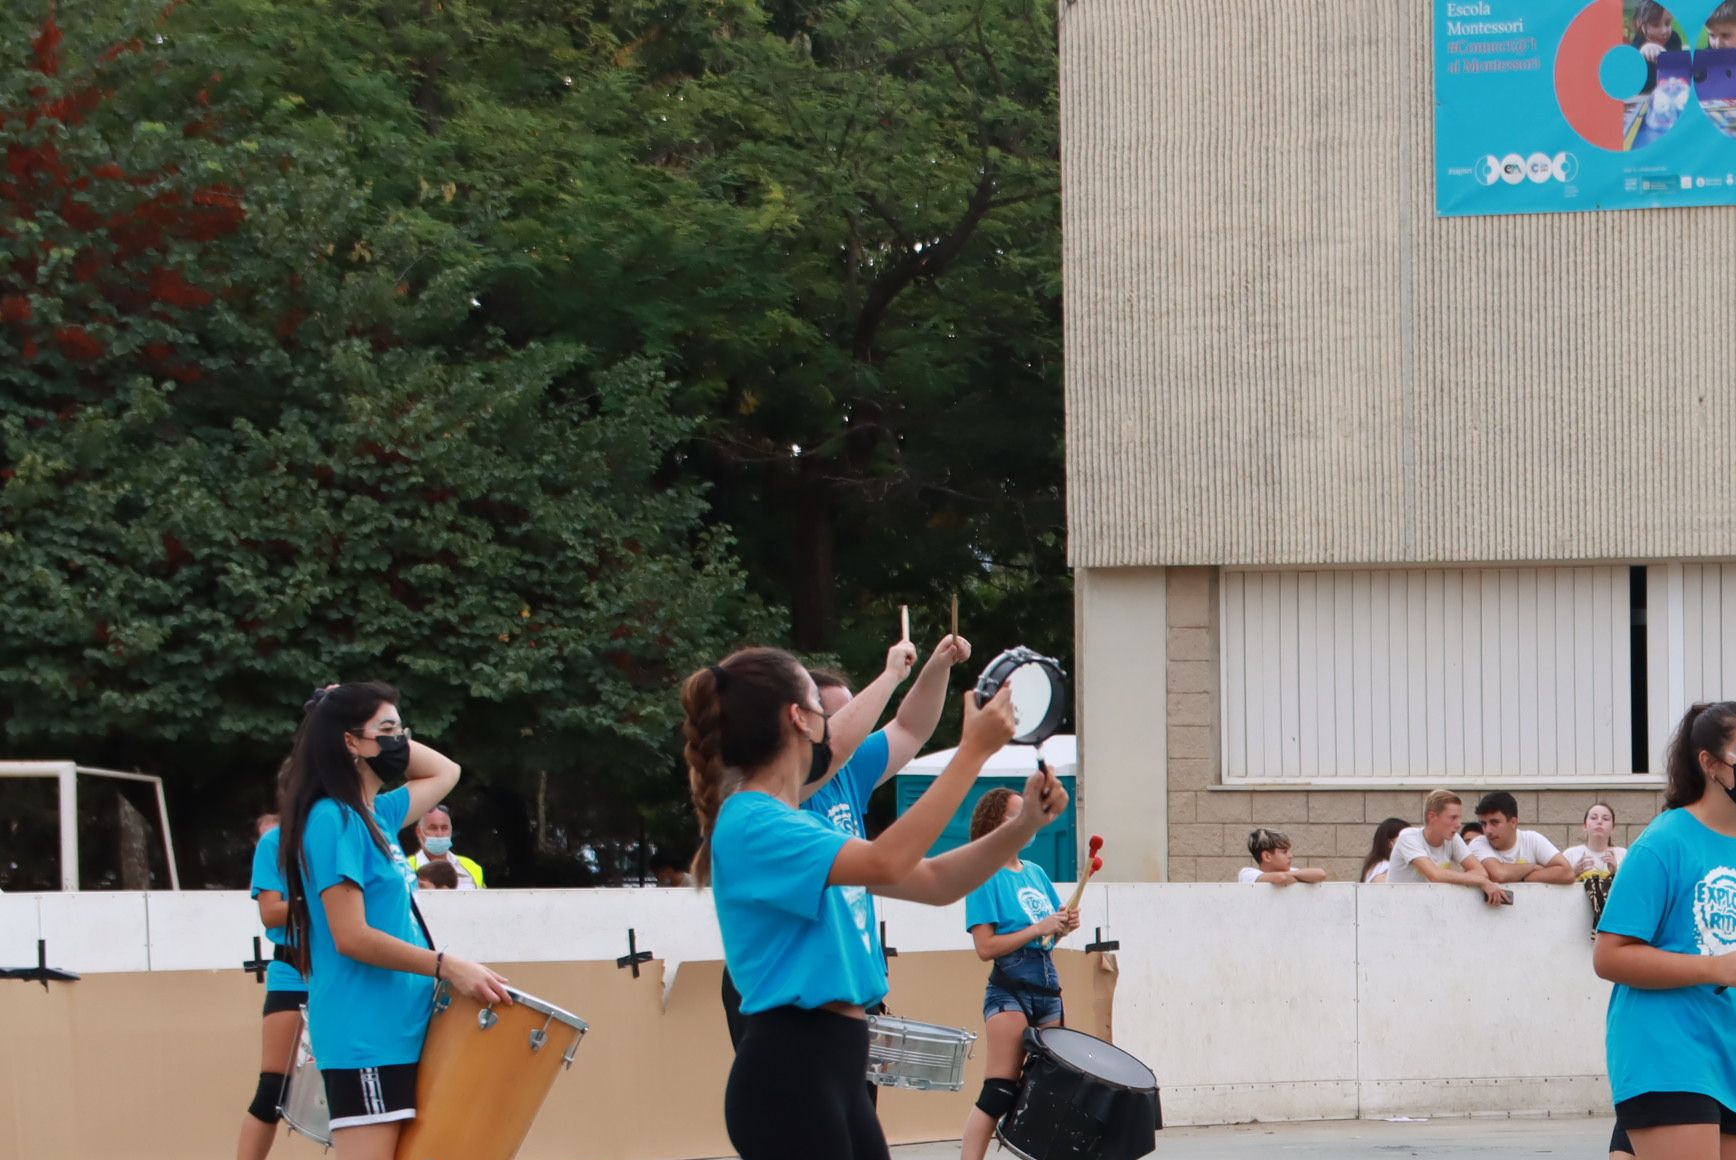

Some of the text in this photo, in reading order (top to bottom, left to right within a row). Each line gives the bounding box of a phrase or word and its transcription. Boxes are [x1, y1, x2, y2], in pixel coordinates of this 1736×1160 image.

[1447, 1, 1491, 17] Escola
[1447, 18, 1523, 36] Montessori
[1464, 57, 1540, 73] Montessori
